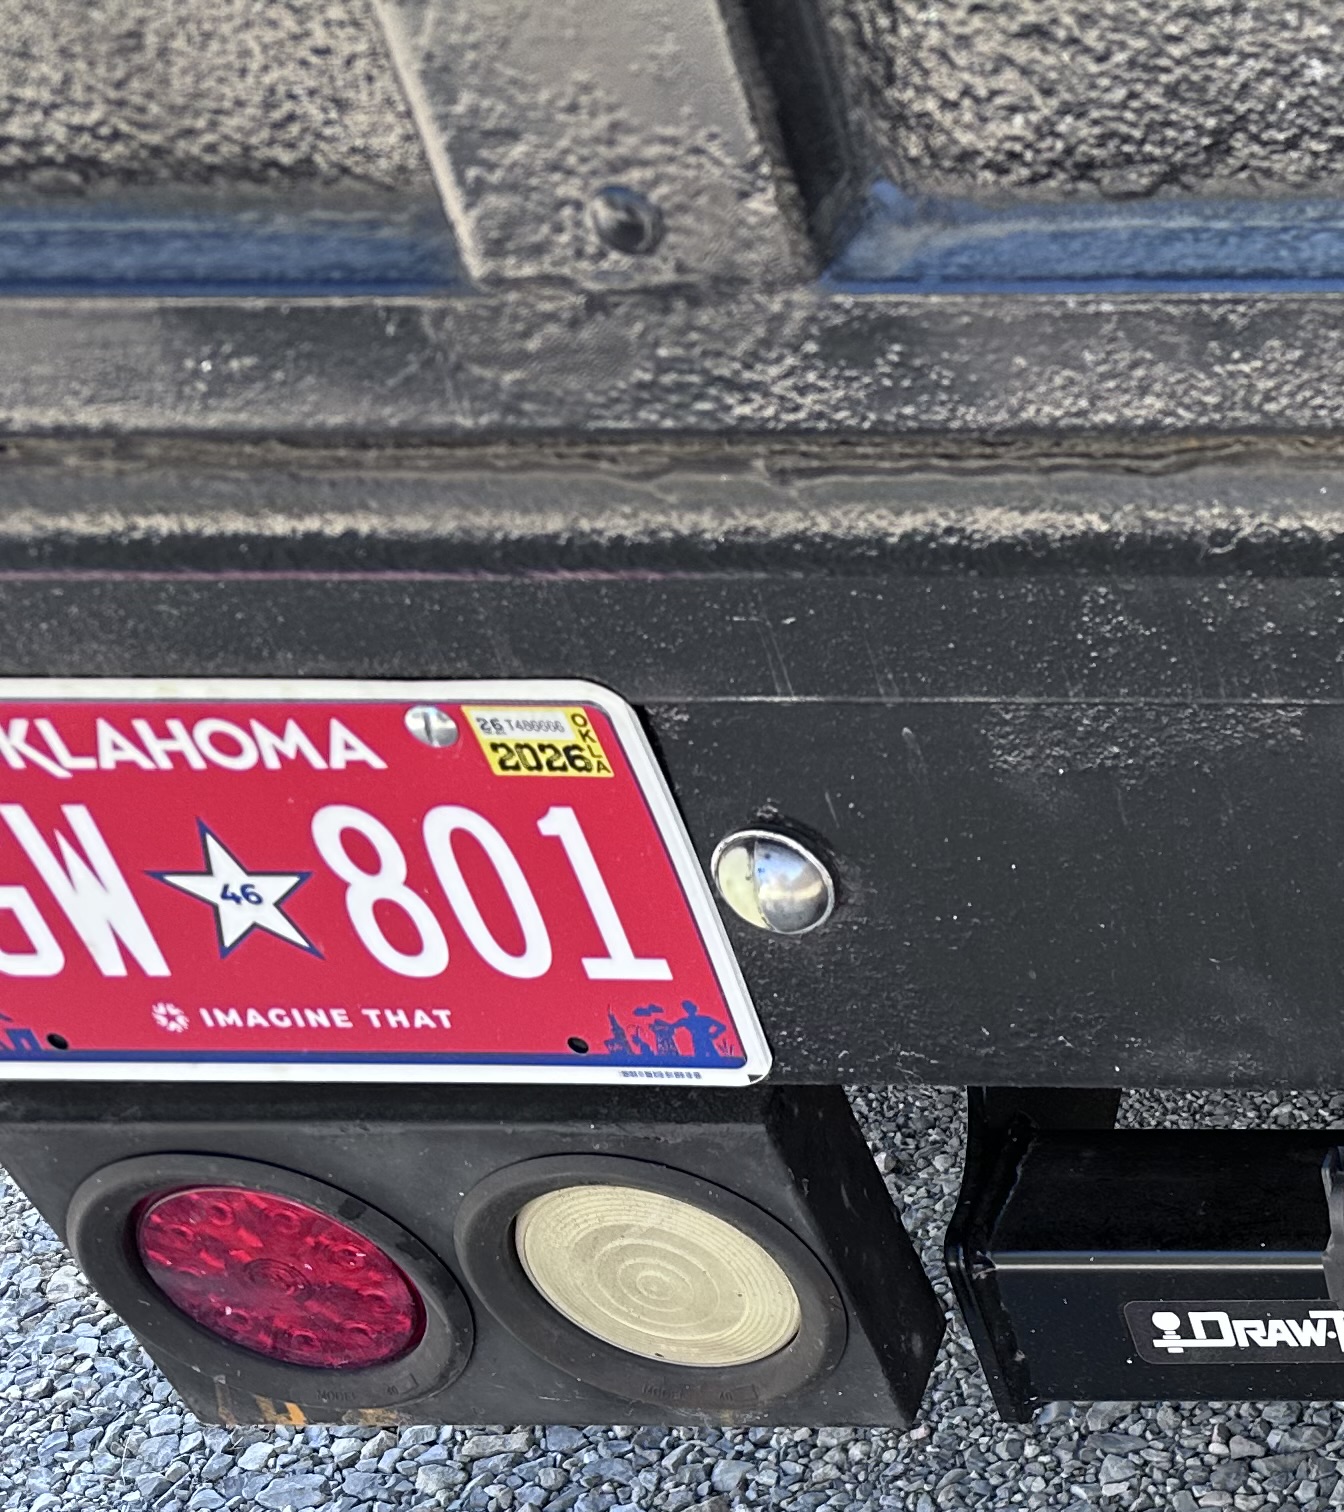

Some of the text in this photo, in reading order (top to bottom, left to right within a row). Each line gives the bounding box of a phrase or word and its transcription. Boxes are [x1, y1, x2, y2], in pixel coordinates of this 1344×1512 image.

[0, 718, 388, 778] KLAHOMA
[489, 742, 593, 773] 2026
[570, 713, 612, 774] OKLA
[220, 883, 264, 906] 46
[311, 804, 673, 982] 801
[199, 1007, 452, 1029] IMAGINE THAT
